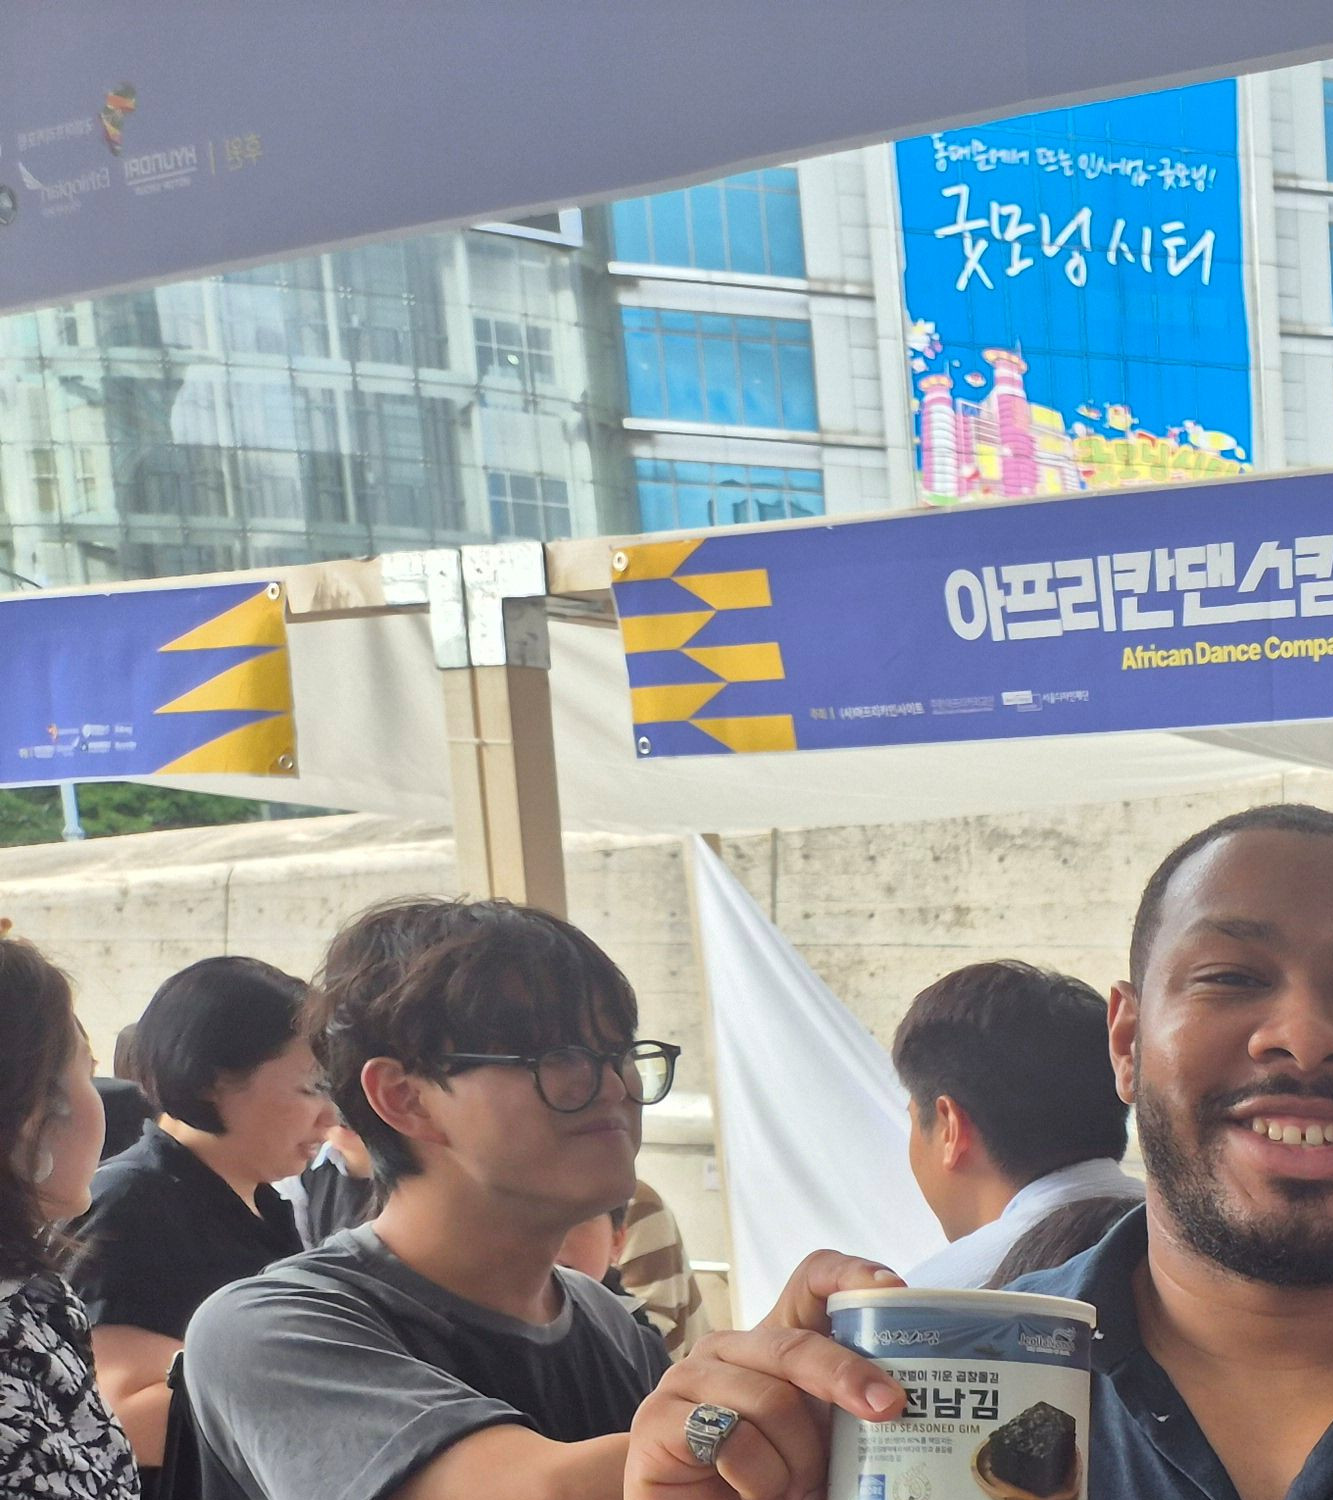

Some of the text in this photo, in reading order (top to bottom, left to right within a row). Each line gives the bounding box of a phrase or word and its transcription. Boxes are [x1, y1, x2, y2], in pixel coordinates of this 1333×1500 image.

[1121, 643, 1194, 671] African
[1195, 638, 1262, 667] Dance
[901, 1387, 999, 1420] 전남김
[900, 1423, 955, 1434] SEASONED
[959, 1423, 981, 1435] GIM
